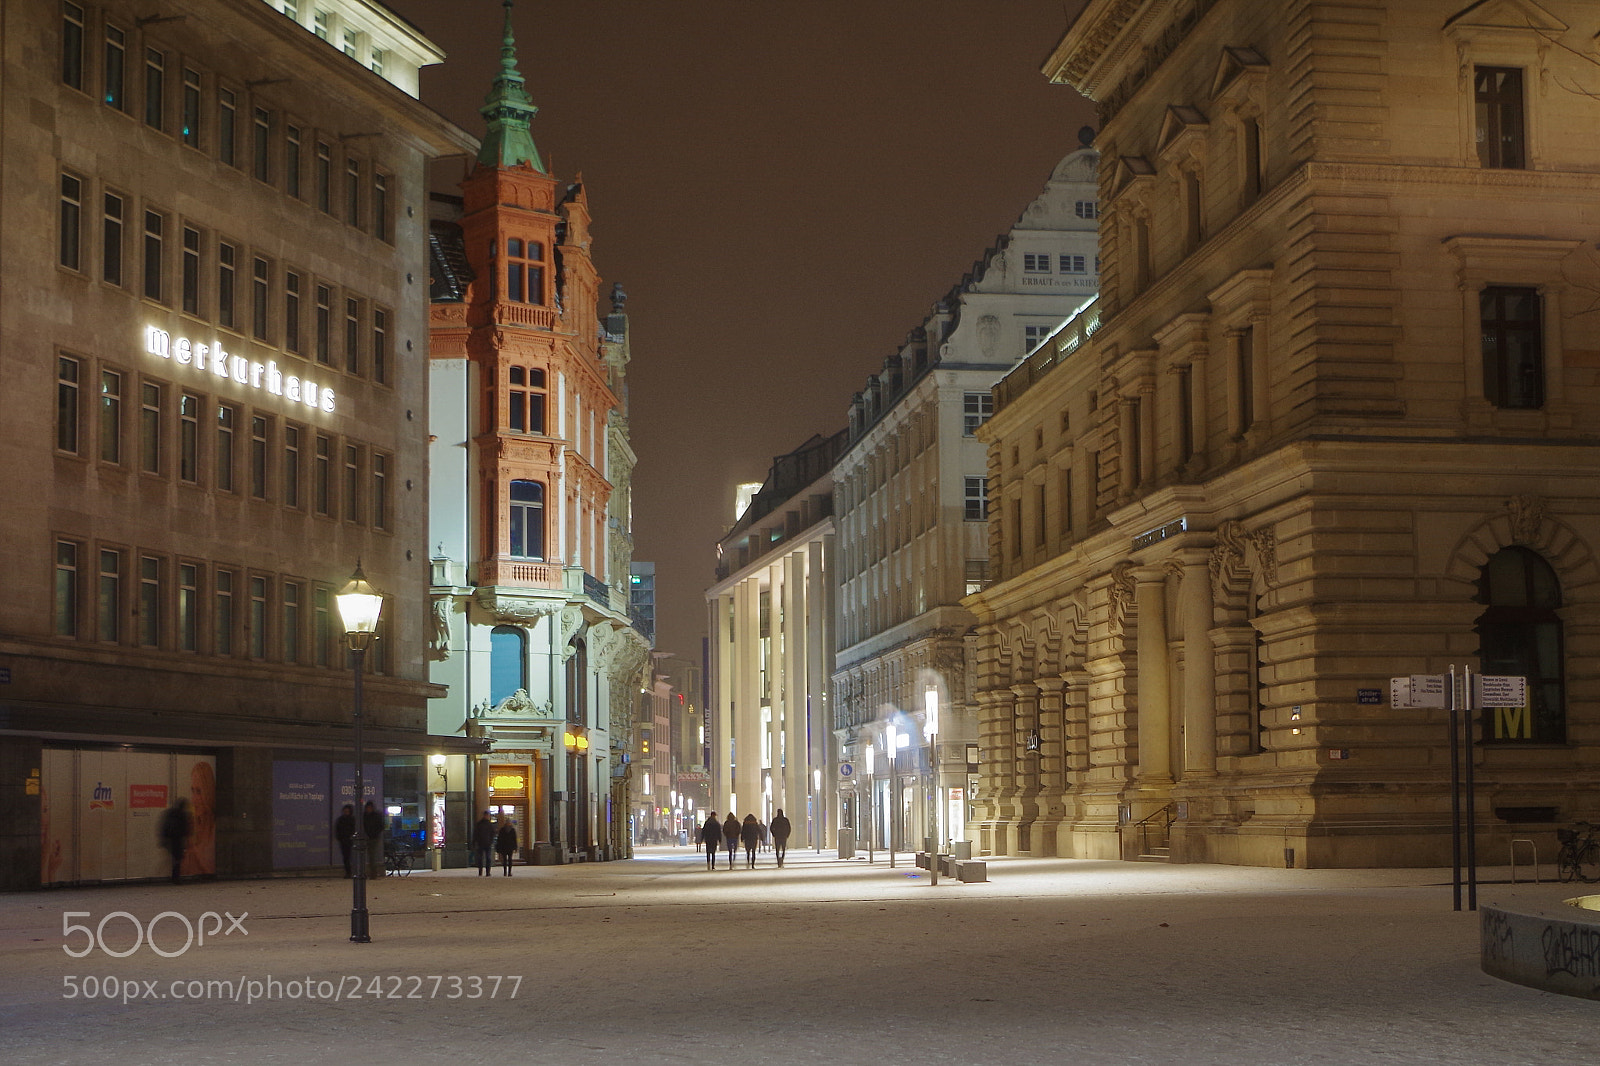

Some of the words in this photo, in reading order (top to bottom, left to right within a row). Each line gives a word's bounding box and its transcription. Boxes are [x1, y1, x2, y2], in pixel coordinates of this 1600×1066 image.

[1022, 277, 1053, 286] ERBAUT
[147, 325, 336, 413] merkurhaus
[93, 782, 112, 801] dm
